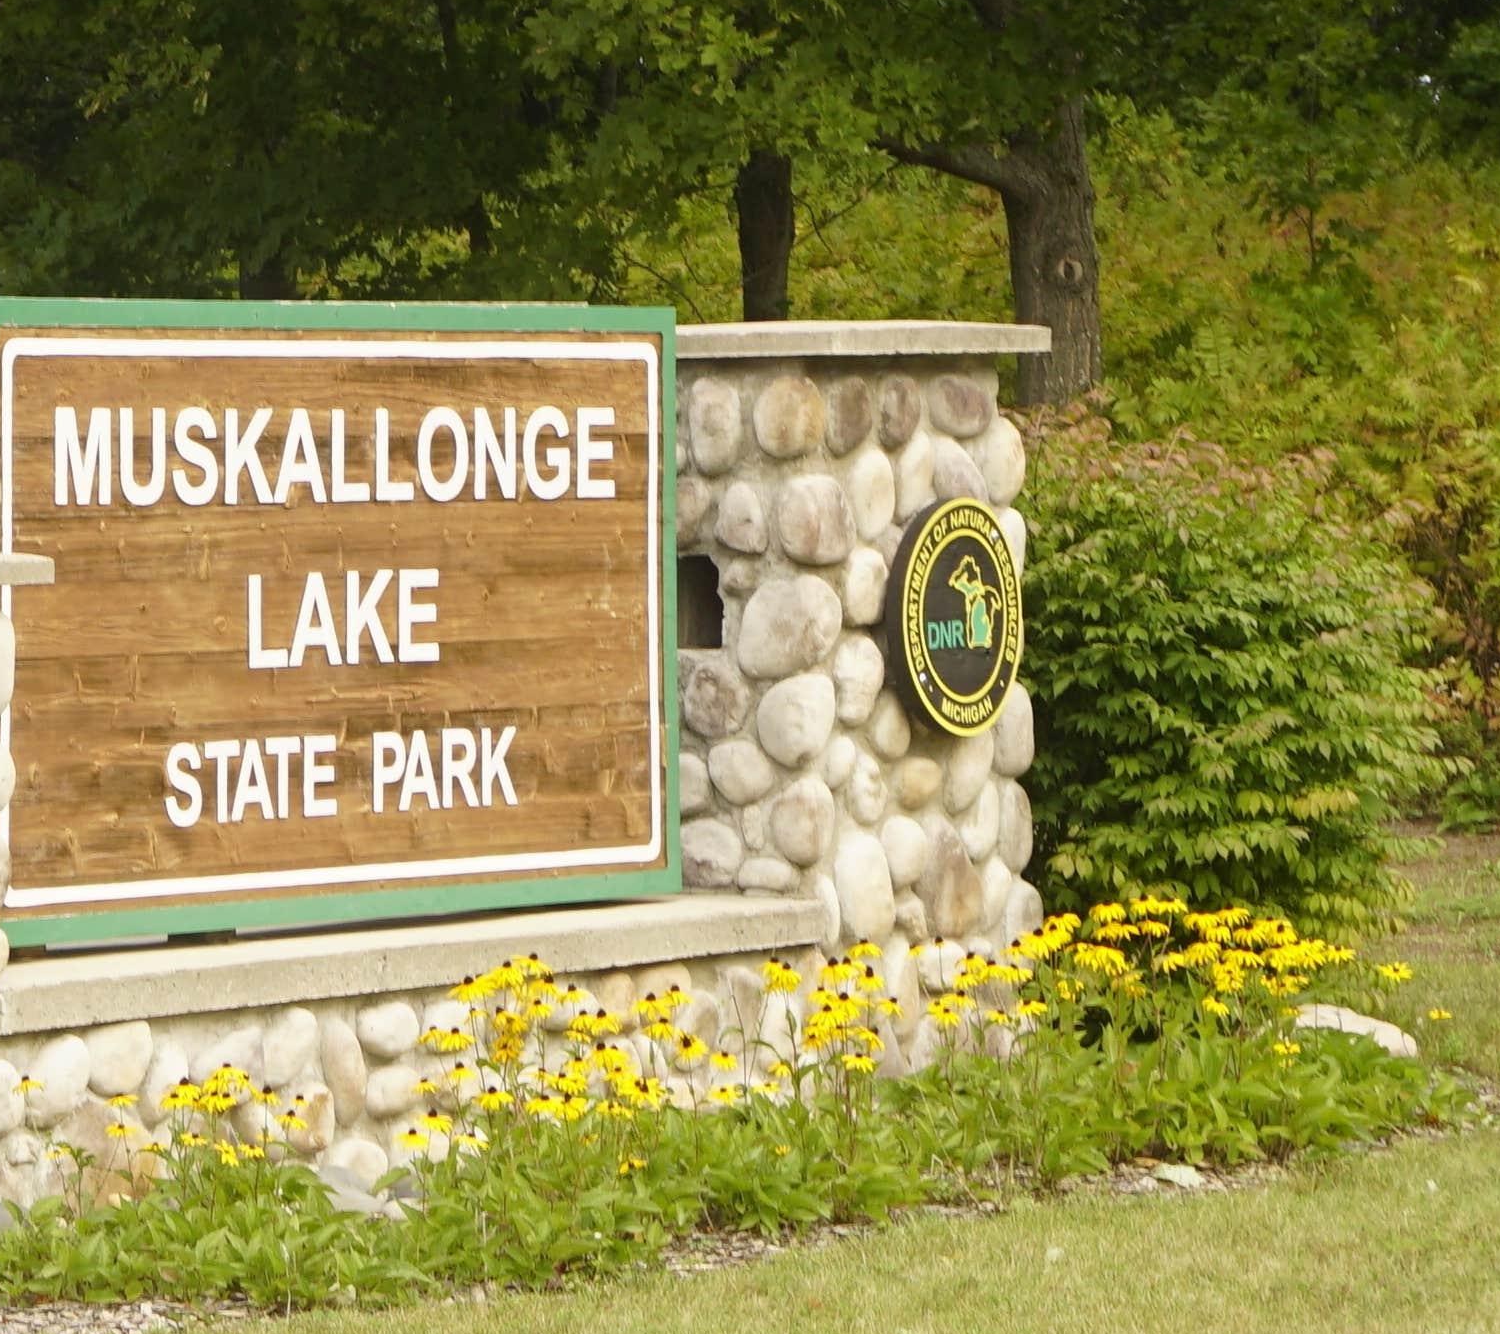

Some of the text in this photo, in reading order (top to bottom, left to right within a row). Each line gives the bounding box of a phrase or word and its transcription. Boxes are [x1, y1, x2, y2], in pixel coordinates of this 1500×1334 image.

[53, 406, 617, 507] MUSKALLONGE
[247, 568, 441, 670] LAKE
[908, 535, 934, 671] DEPARTMENT
[933, 516, 948, 543] OF
[994, 538, 1017, 664] RESOURCES
[927, 620, 965, 650] DNR
[941, 695, 994, 724] MICHIGAN
[164, 726, 519, 829] STATE PARK
